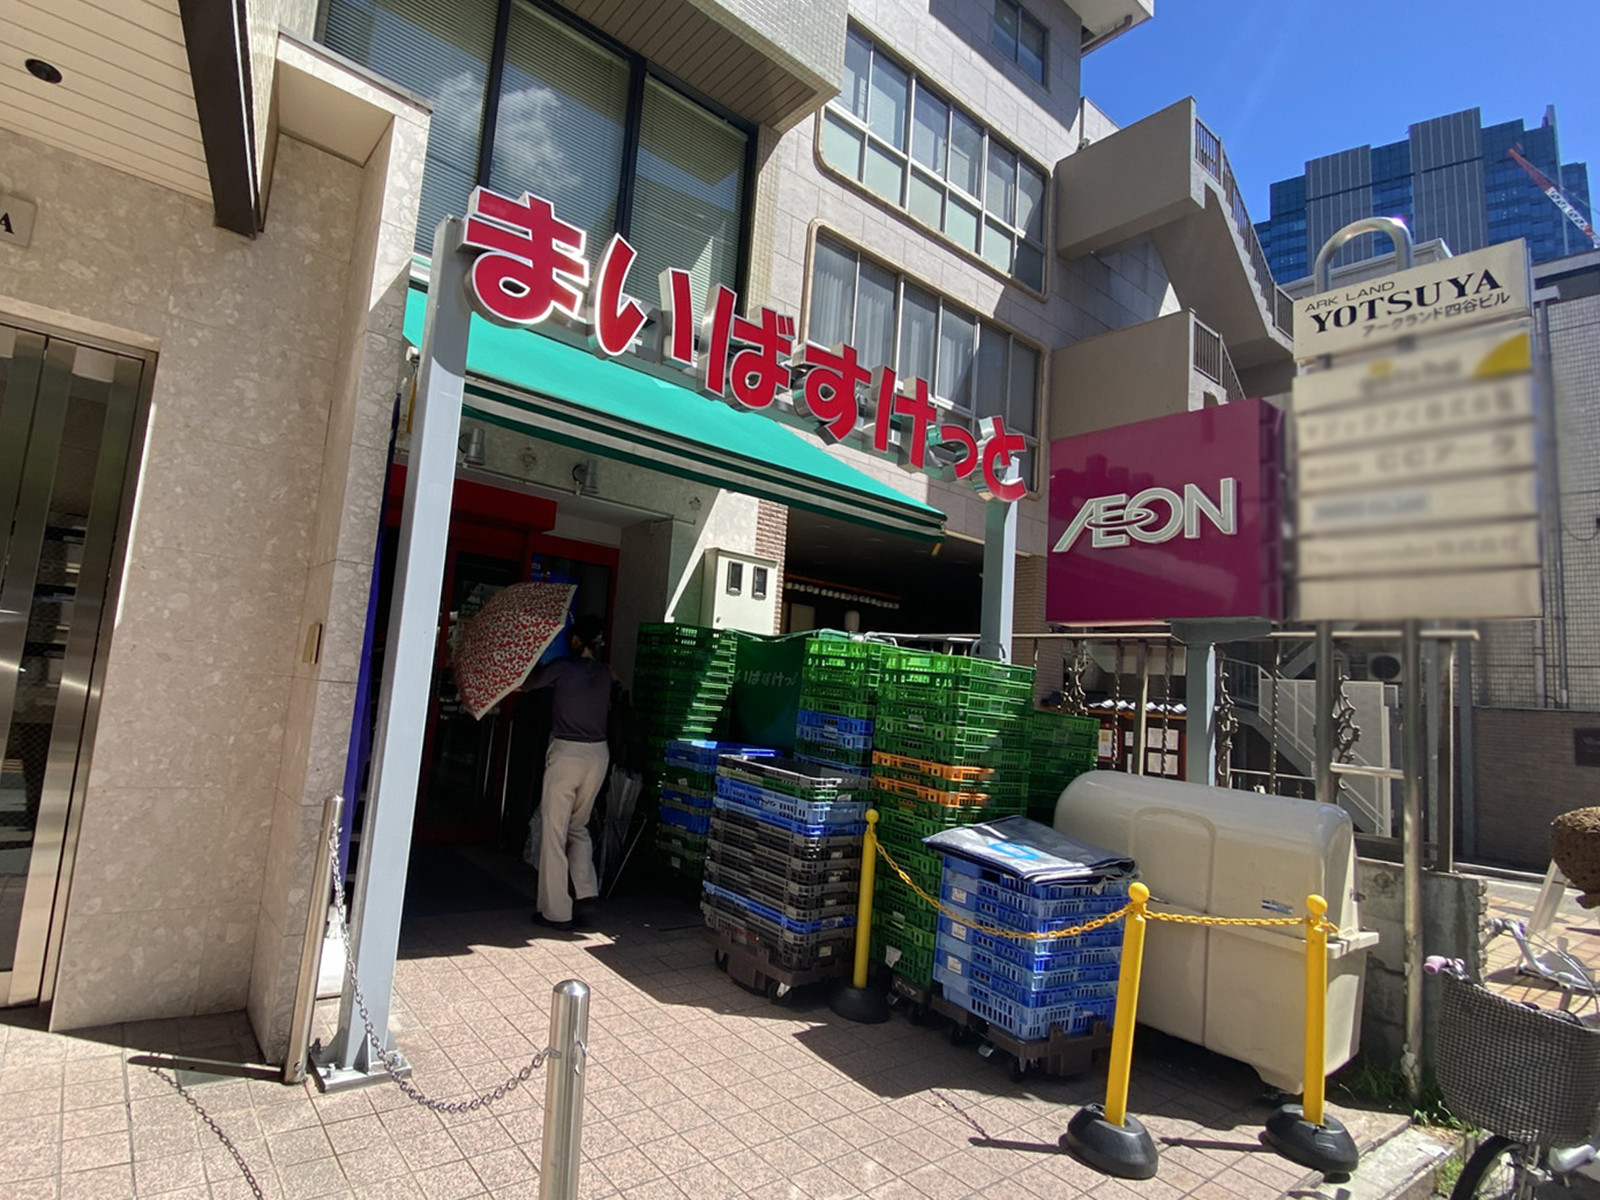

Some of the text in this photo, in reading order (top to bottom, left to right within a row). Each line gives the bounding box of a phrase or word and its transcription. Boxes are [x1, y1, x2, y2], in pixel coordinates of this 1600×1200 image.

[1305, 281, 1395, 313] ARK LAND
[1310, 269, 1502, 333] YOTSUYA
[1362, 291, 1511, 337] アークランド四谷ビル
[461, 185, 1028, 502] まいばすけっと
[1052, 477, 1237, 552] AEON
